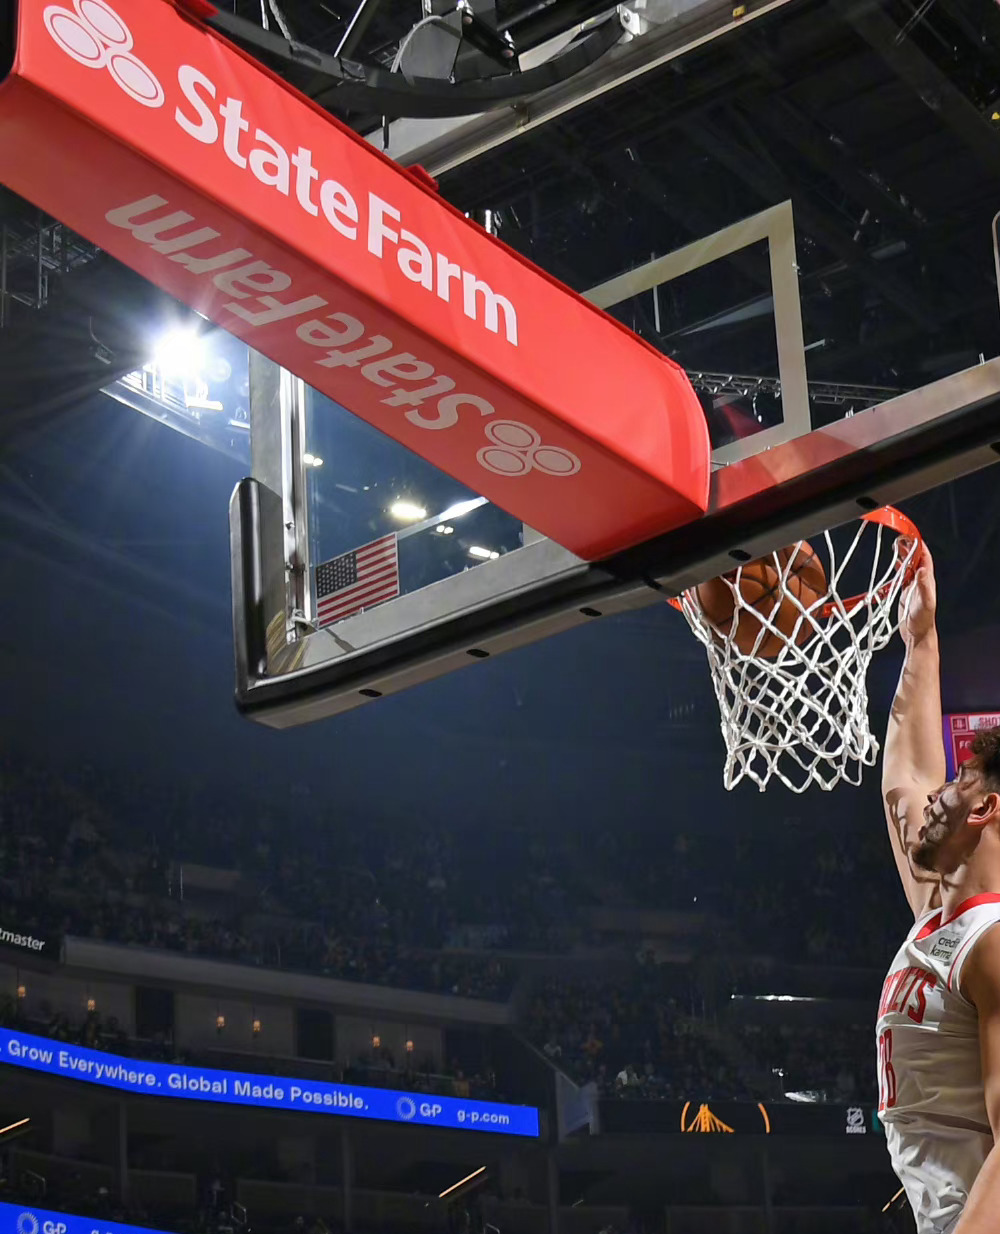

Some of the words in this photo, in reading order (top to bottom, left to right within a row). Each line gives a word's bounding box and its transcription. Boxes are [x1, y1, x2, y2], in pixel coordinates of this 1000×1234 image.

[8, 1040, 53, 1064] Grow
[59, 1051, 162, 1088] Everywhere.
[168, 1073, 228, 1095] Global
[234, 1080, 284, 1100] Made
[290, 1086, 369, 1110] Possible.
[457, 1110, 510, 1125] g-p.com
